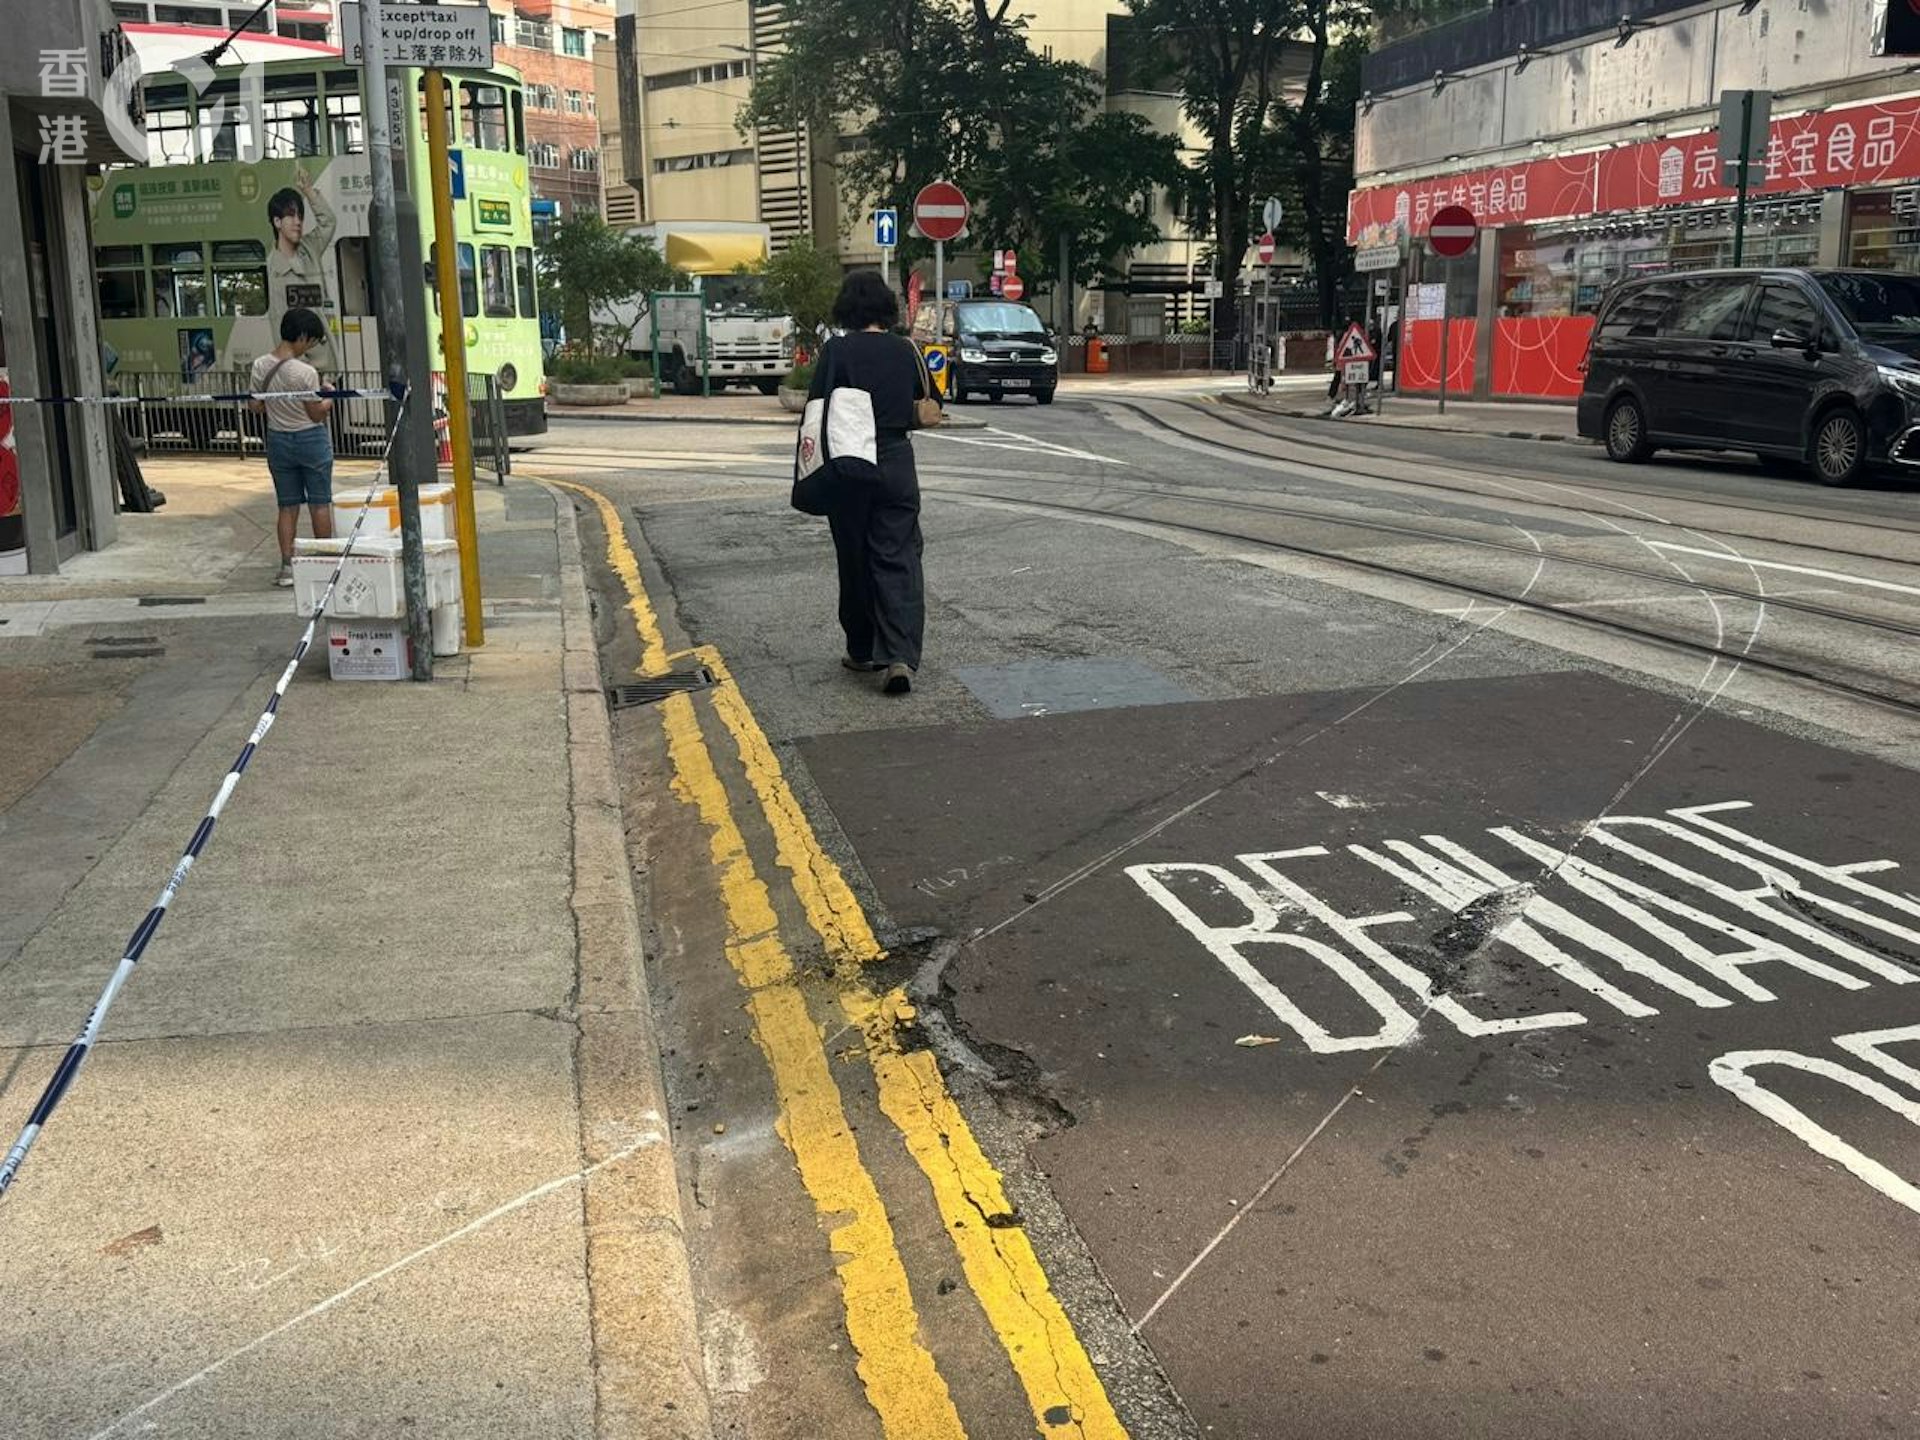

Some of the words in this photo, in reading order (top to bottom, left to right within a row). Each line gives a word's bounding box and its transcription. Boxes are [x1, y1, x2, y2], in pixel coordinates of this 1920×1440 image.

[394, 28, 451, 41] up/drop
[455, 28, 475, 40] off
[431, 11, 457, 22] taxi
[1693, 116, 1896, 189] 京佳宝食品
[1123, 800, 1920, 1053] BEWARE
